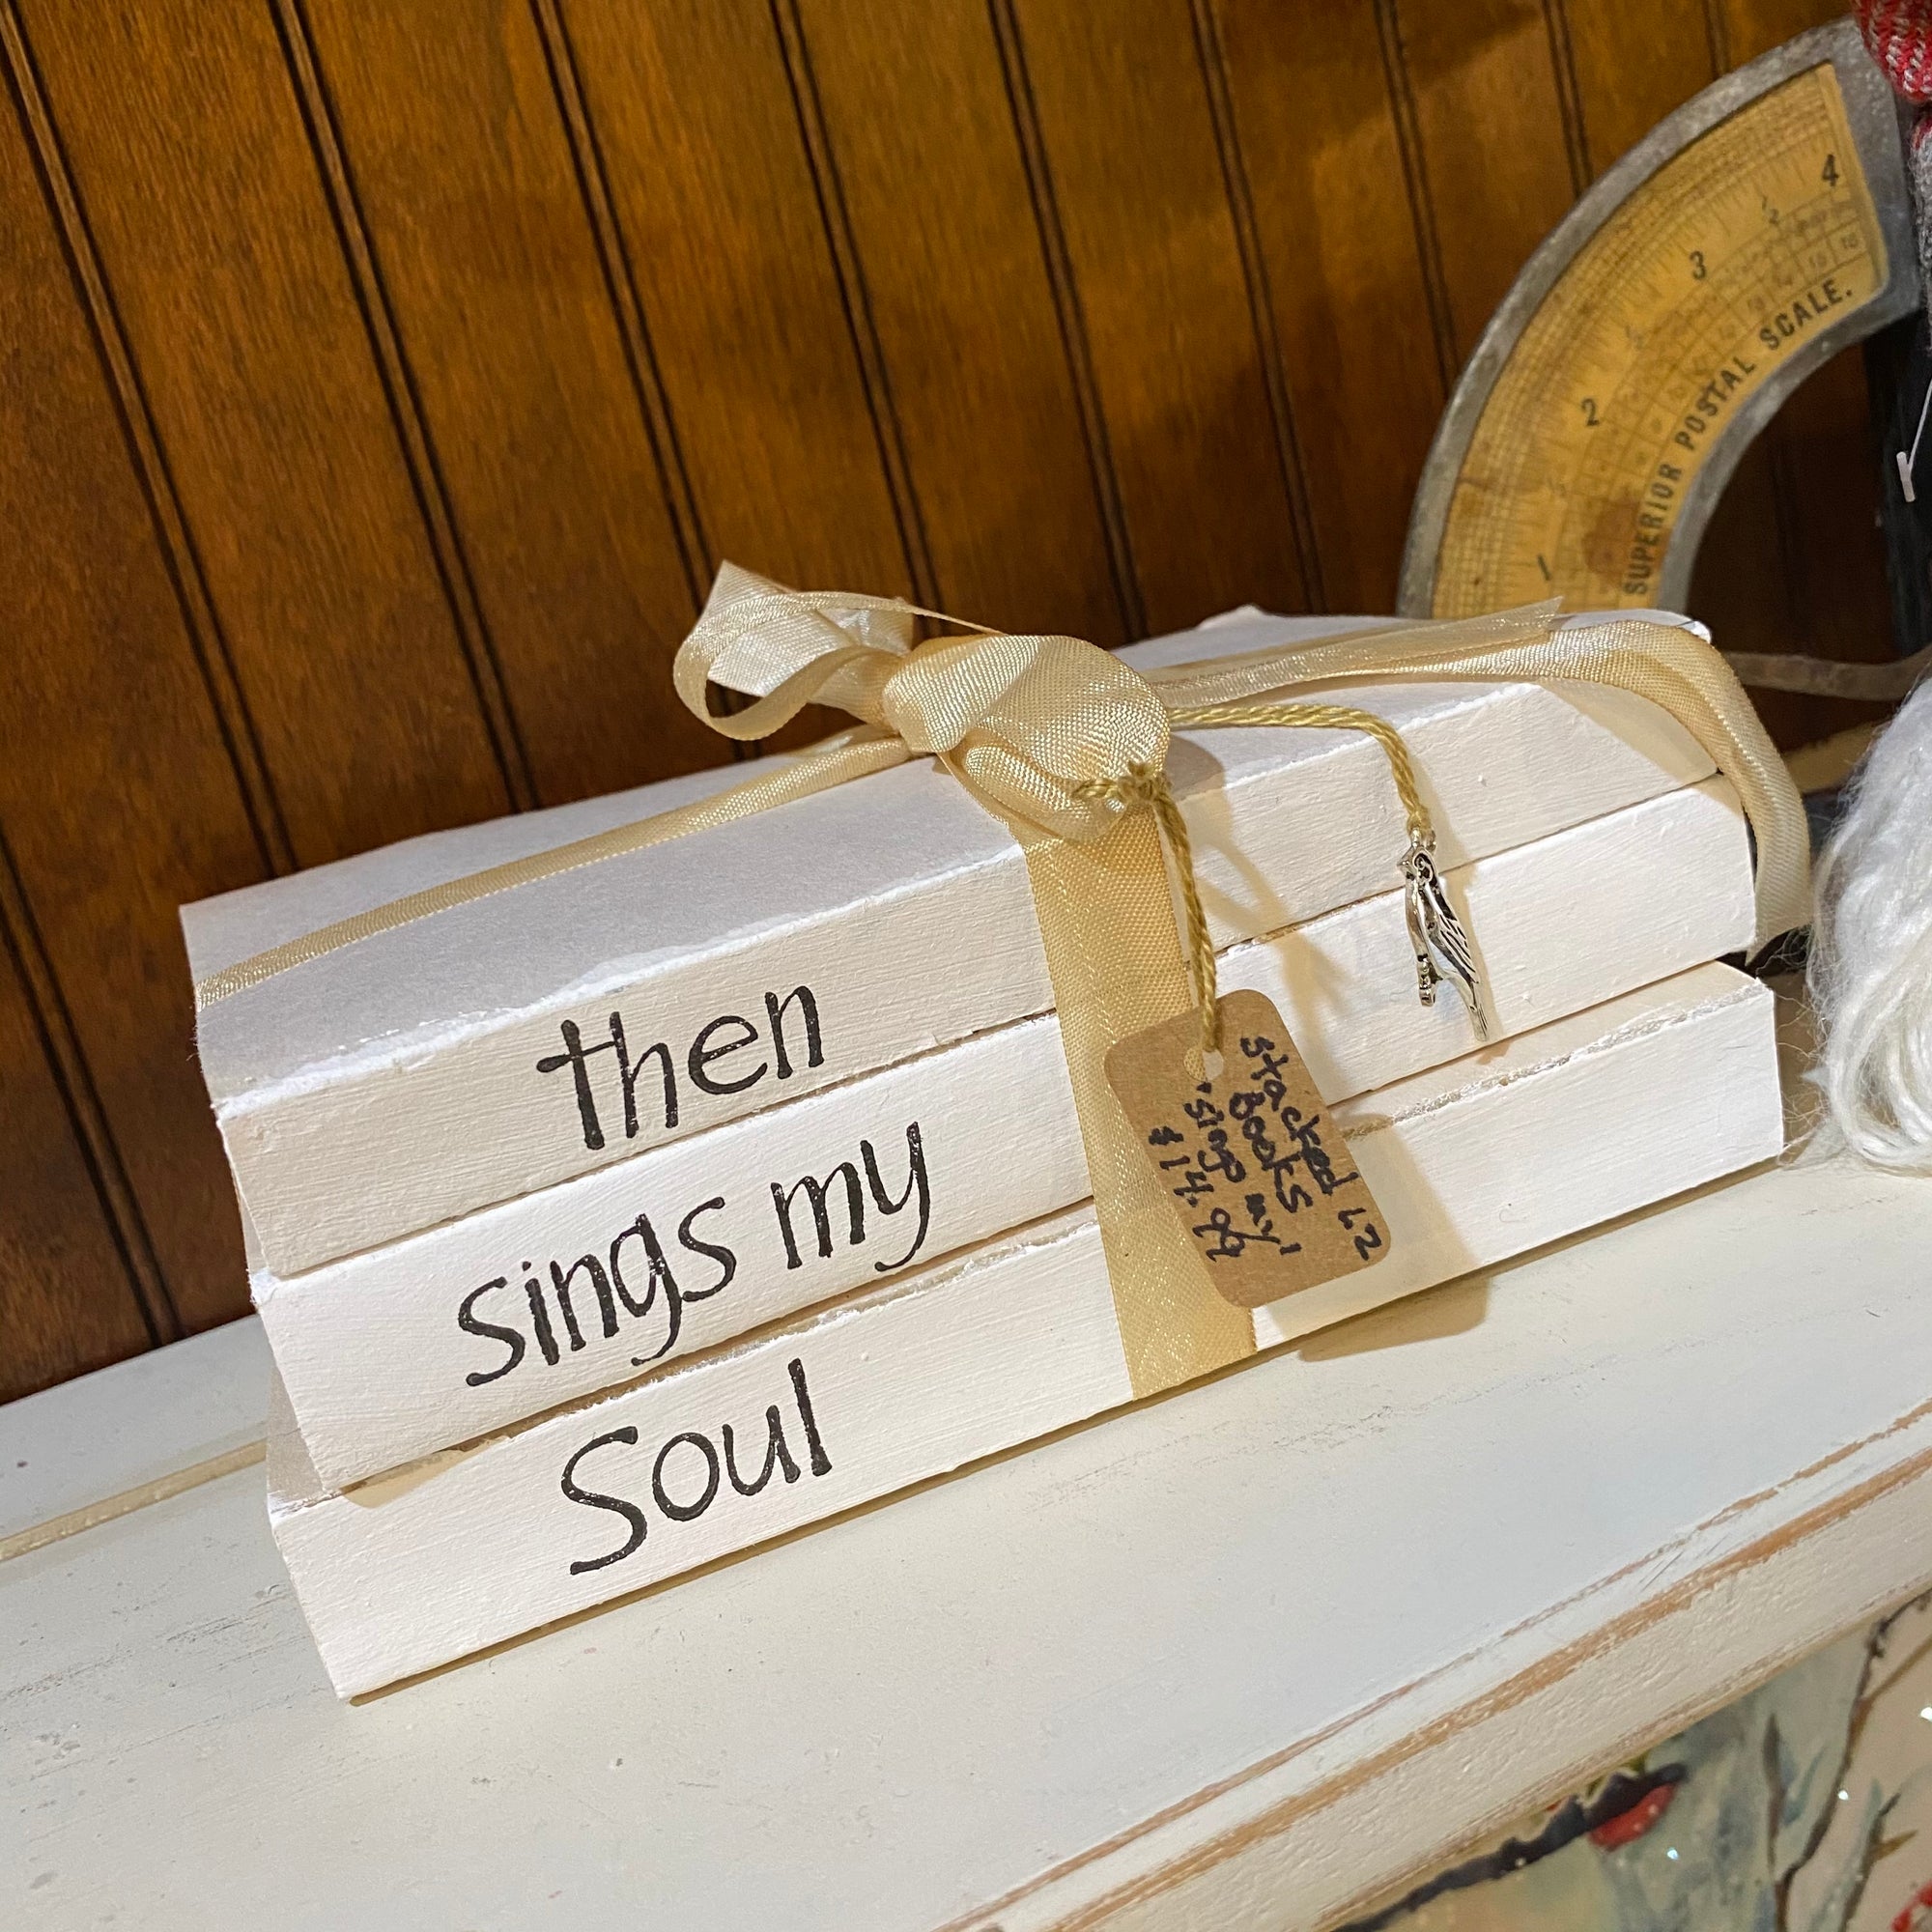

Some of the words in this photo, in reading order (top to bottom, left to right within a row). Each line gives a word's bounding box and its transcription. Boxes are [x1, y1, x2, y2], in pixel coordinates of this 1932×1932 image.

[1822, 154, 1838, 186] 4
[1690, 250, 1706, 280] 3
[1580, 397, 1600, 426] 2
[1623, 464, 1682, 595] SUPERIOR
[1674, 355, 1756, 451] POSTAL
[1759, 278, 1852, 351] SCALE.
[537, 986, 824, 1150] then
[458, 1197, 736, 1386] sings
[771, 1122, 930, 1271] my
[1149, 1126, 1243, 1262] $14.99
